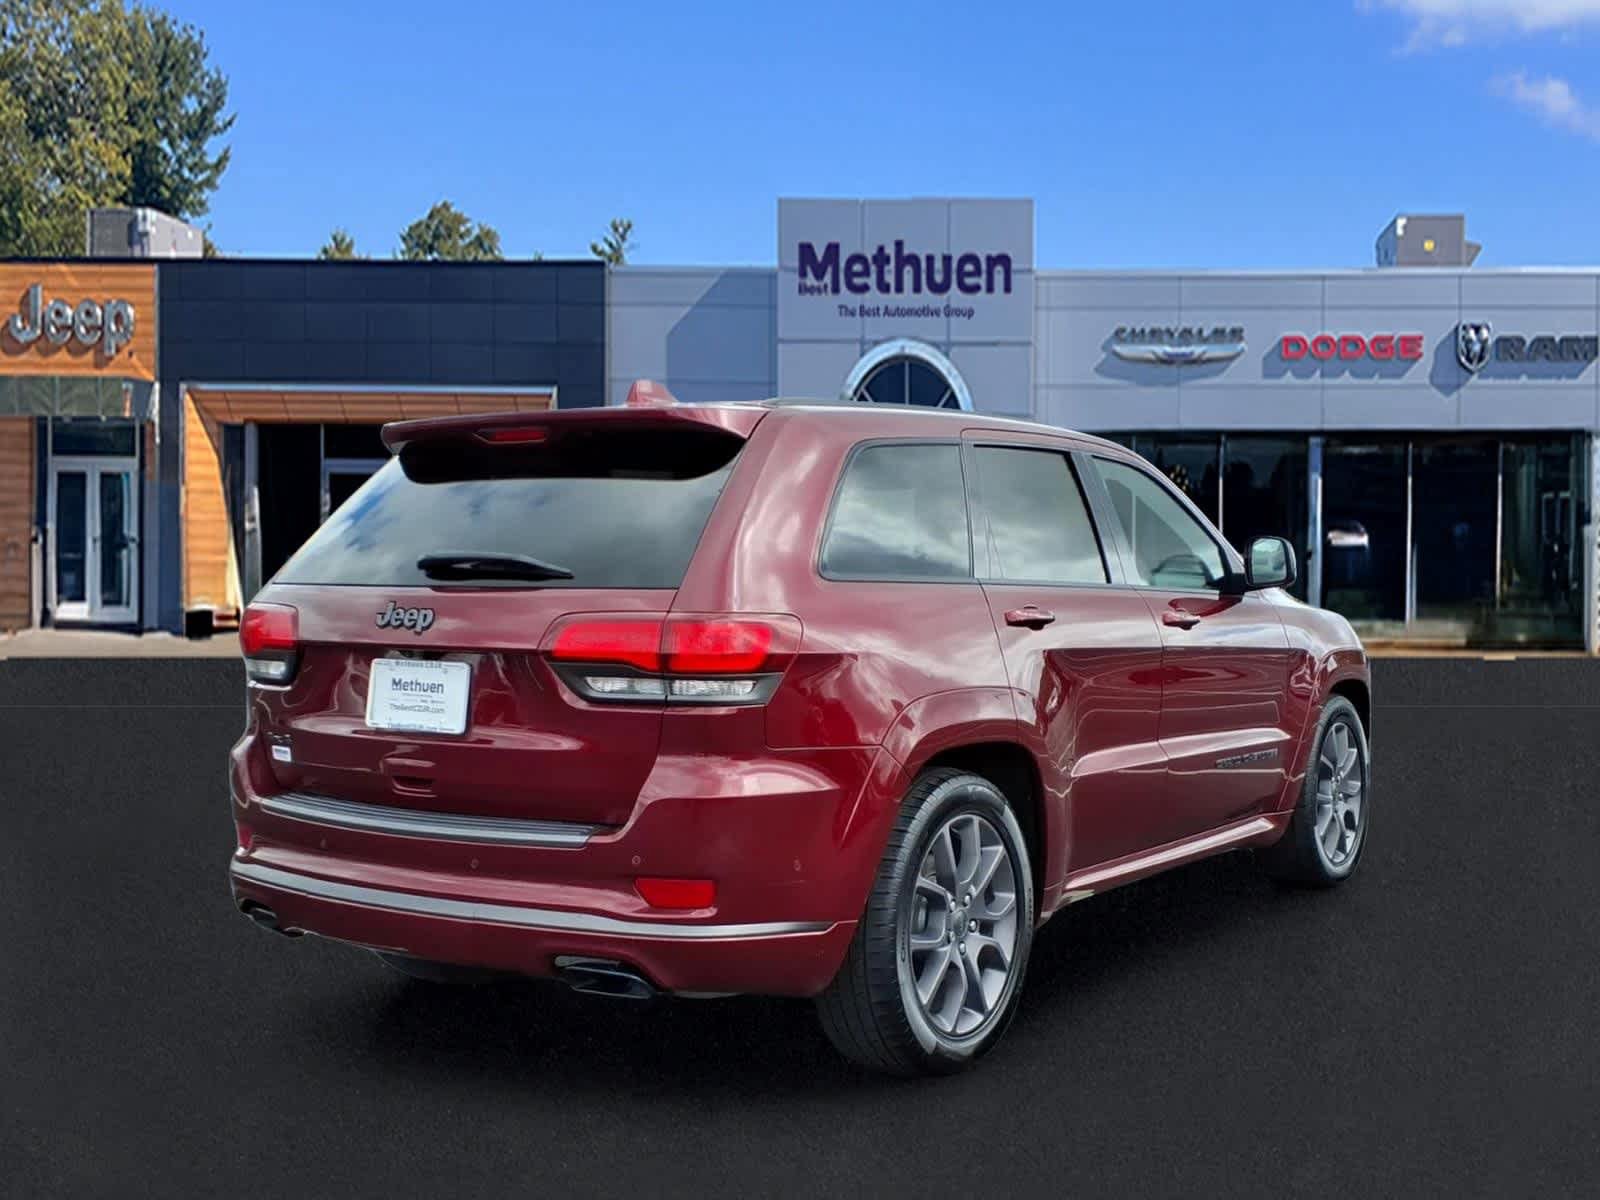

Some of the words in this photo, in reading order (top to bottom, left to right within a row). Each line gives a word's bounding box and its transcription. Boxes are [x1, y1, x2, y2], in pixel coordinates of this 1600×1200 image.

[798, 240, 1012, 295] Methuen
[9, 283, 135, 356] Jeep
[838, 304, 857, 318] The
[859, 304, 881, 318] Best
[883, 304, 941, 318] Automotive
[943, 304, 975, 320] Group
[1282, 334, 1424, 360] DODGE
[1495, 336, 1599, 362] RAM
[375, 601, 435, 635] Jeep
[391, 678, 444, 694] Methuen
